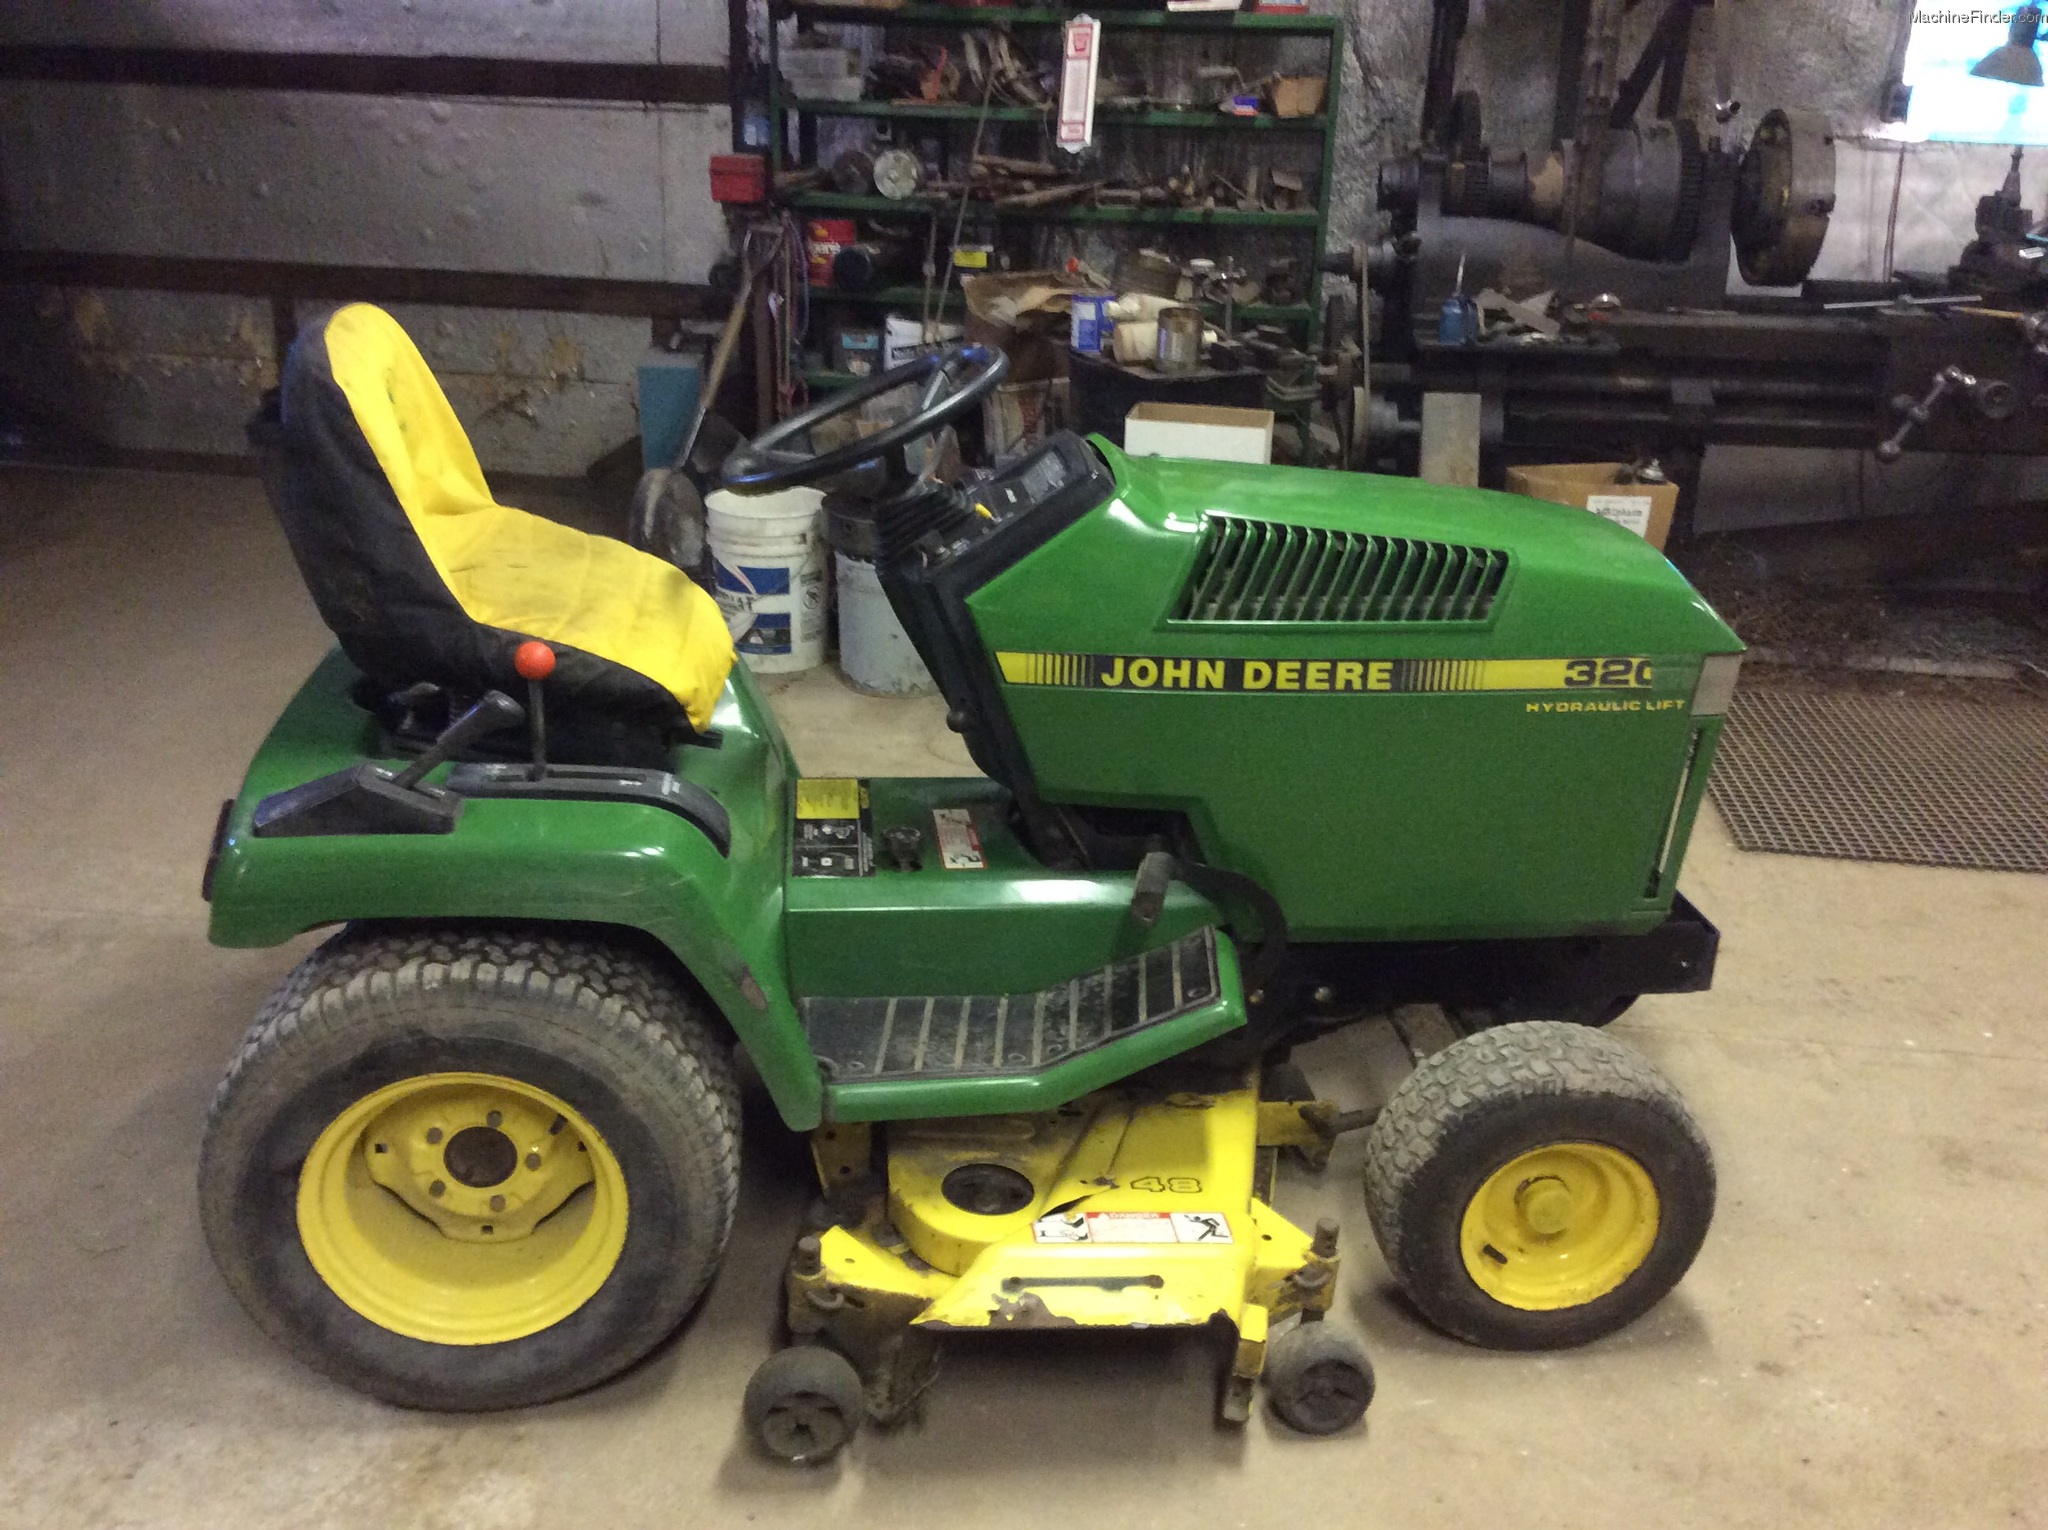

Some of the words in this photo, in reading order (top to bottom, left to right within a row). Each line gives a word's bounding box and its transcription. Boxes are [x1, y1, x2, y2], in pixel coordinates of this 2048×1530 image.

[1101, 657, 1225, 689] JOHN
[1242, 660, 1394, 690] DEERE
[1526, 701, 1641, 712] HYDRAULIC
[1646, 699, 1685, 711] LIFT
[1130, 1176, 1202, 1193] 48
